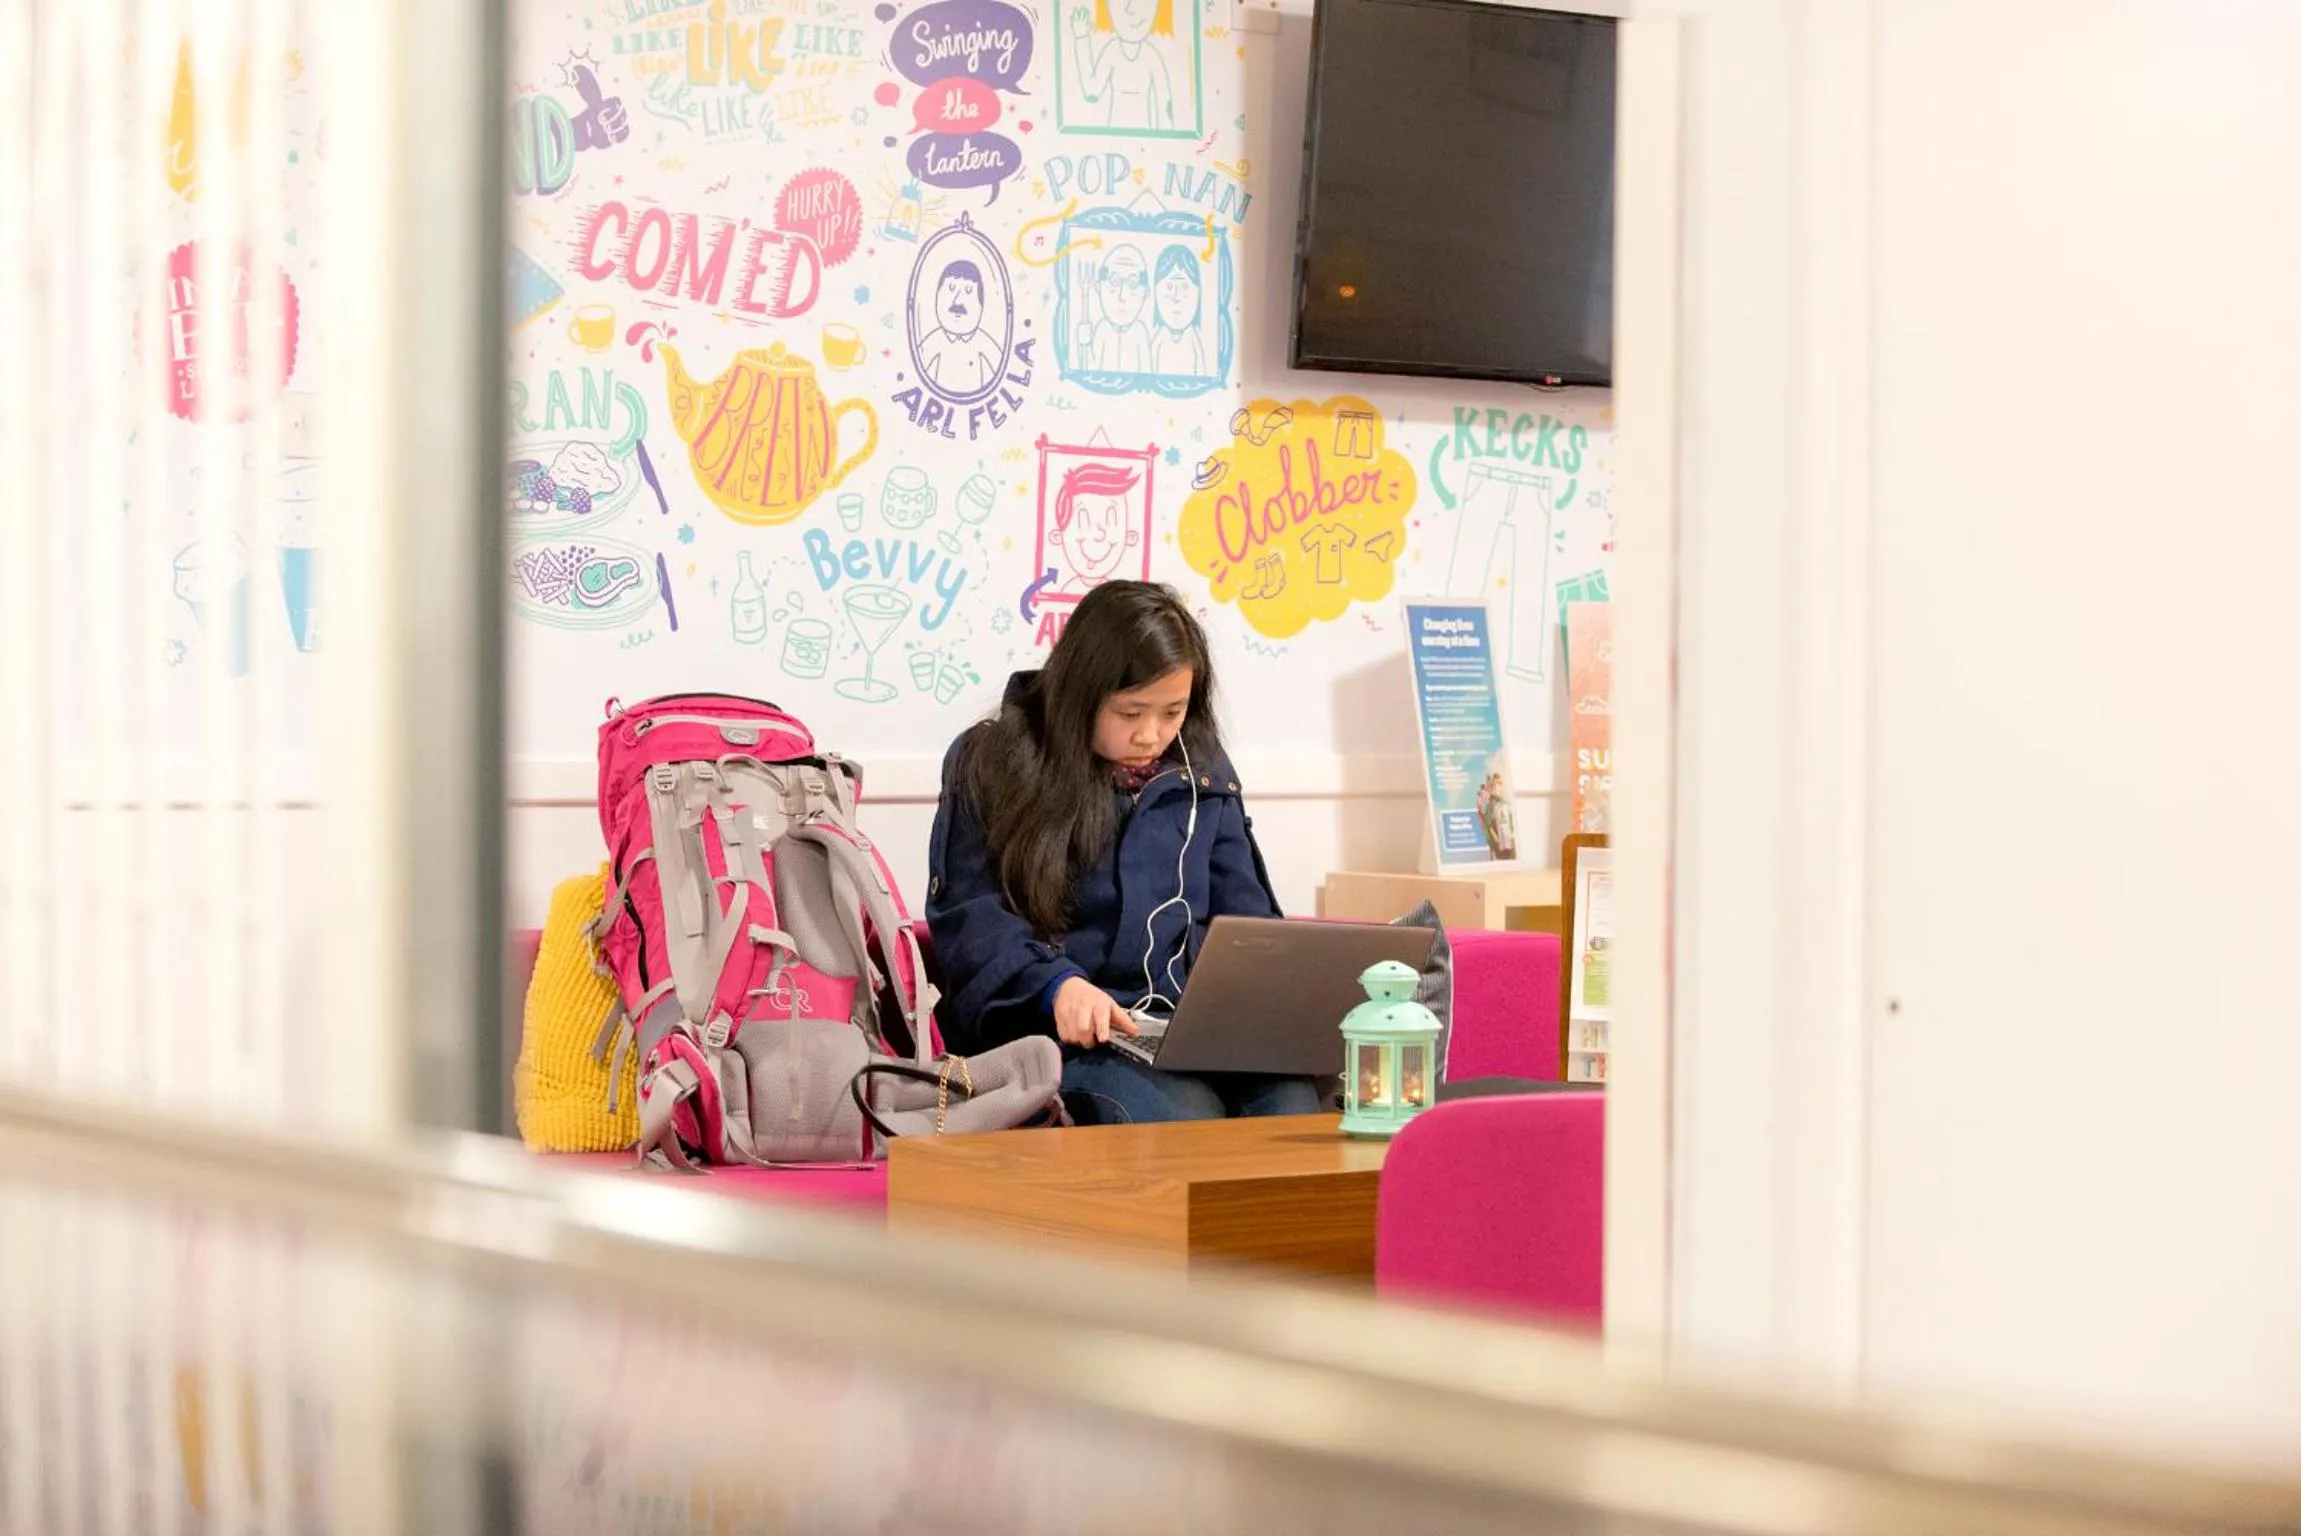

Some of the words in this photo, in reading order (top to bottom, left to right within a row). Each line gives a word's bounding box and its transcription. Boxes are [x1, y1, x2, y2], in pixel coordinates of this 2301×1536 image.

[793, 23, 863, 57] LIKE
[911, 20, 1020, 75] Swinging
[702, 94, 754, 138] LIKE
[941, 89, 981, 120] the
[787, 177, 845, 224] HURRY
[1043, 151, 1131, 202] POP
[1164, 162, 1253, 225] NAN
[891, 386, 956, 440] ARL
[969, 337, 1037, 441] FELLA
[1452, 406, 1588, 475] KECKS
[1214, 438, 1384, 564] Clobber
[802, 527, 969, 631] Bevvy
